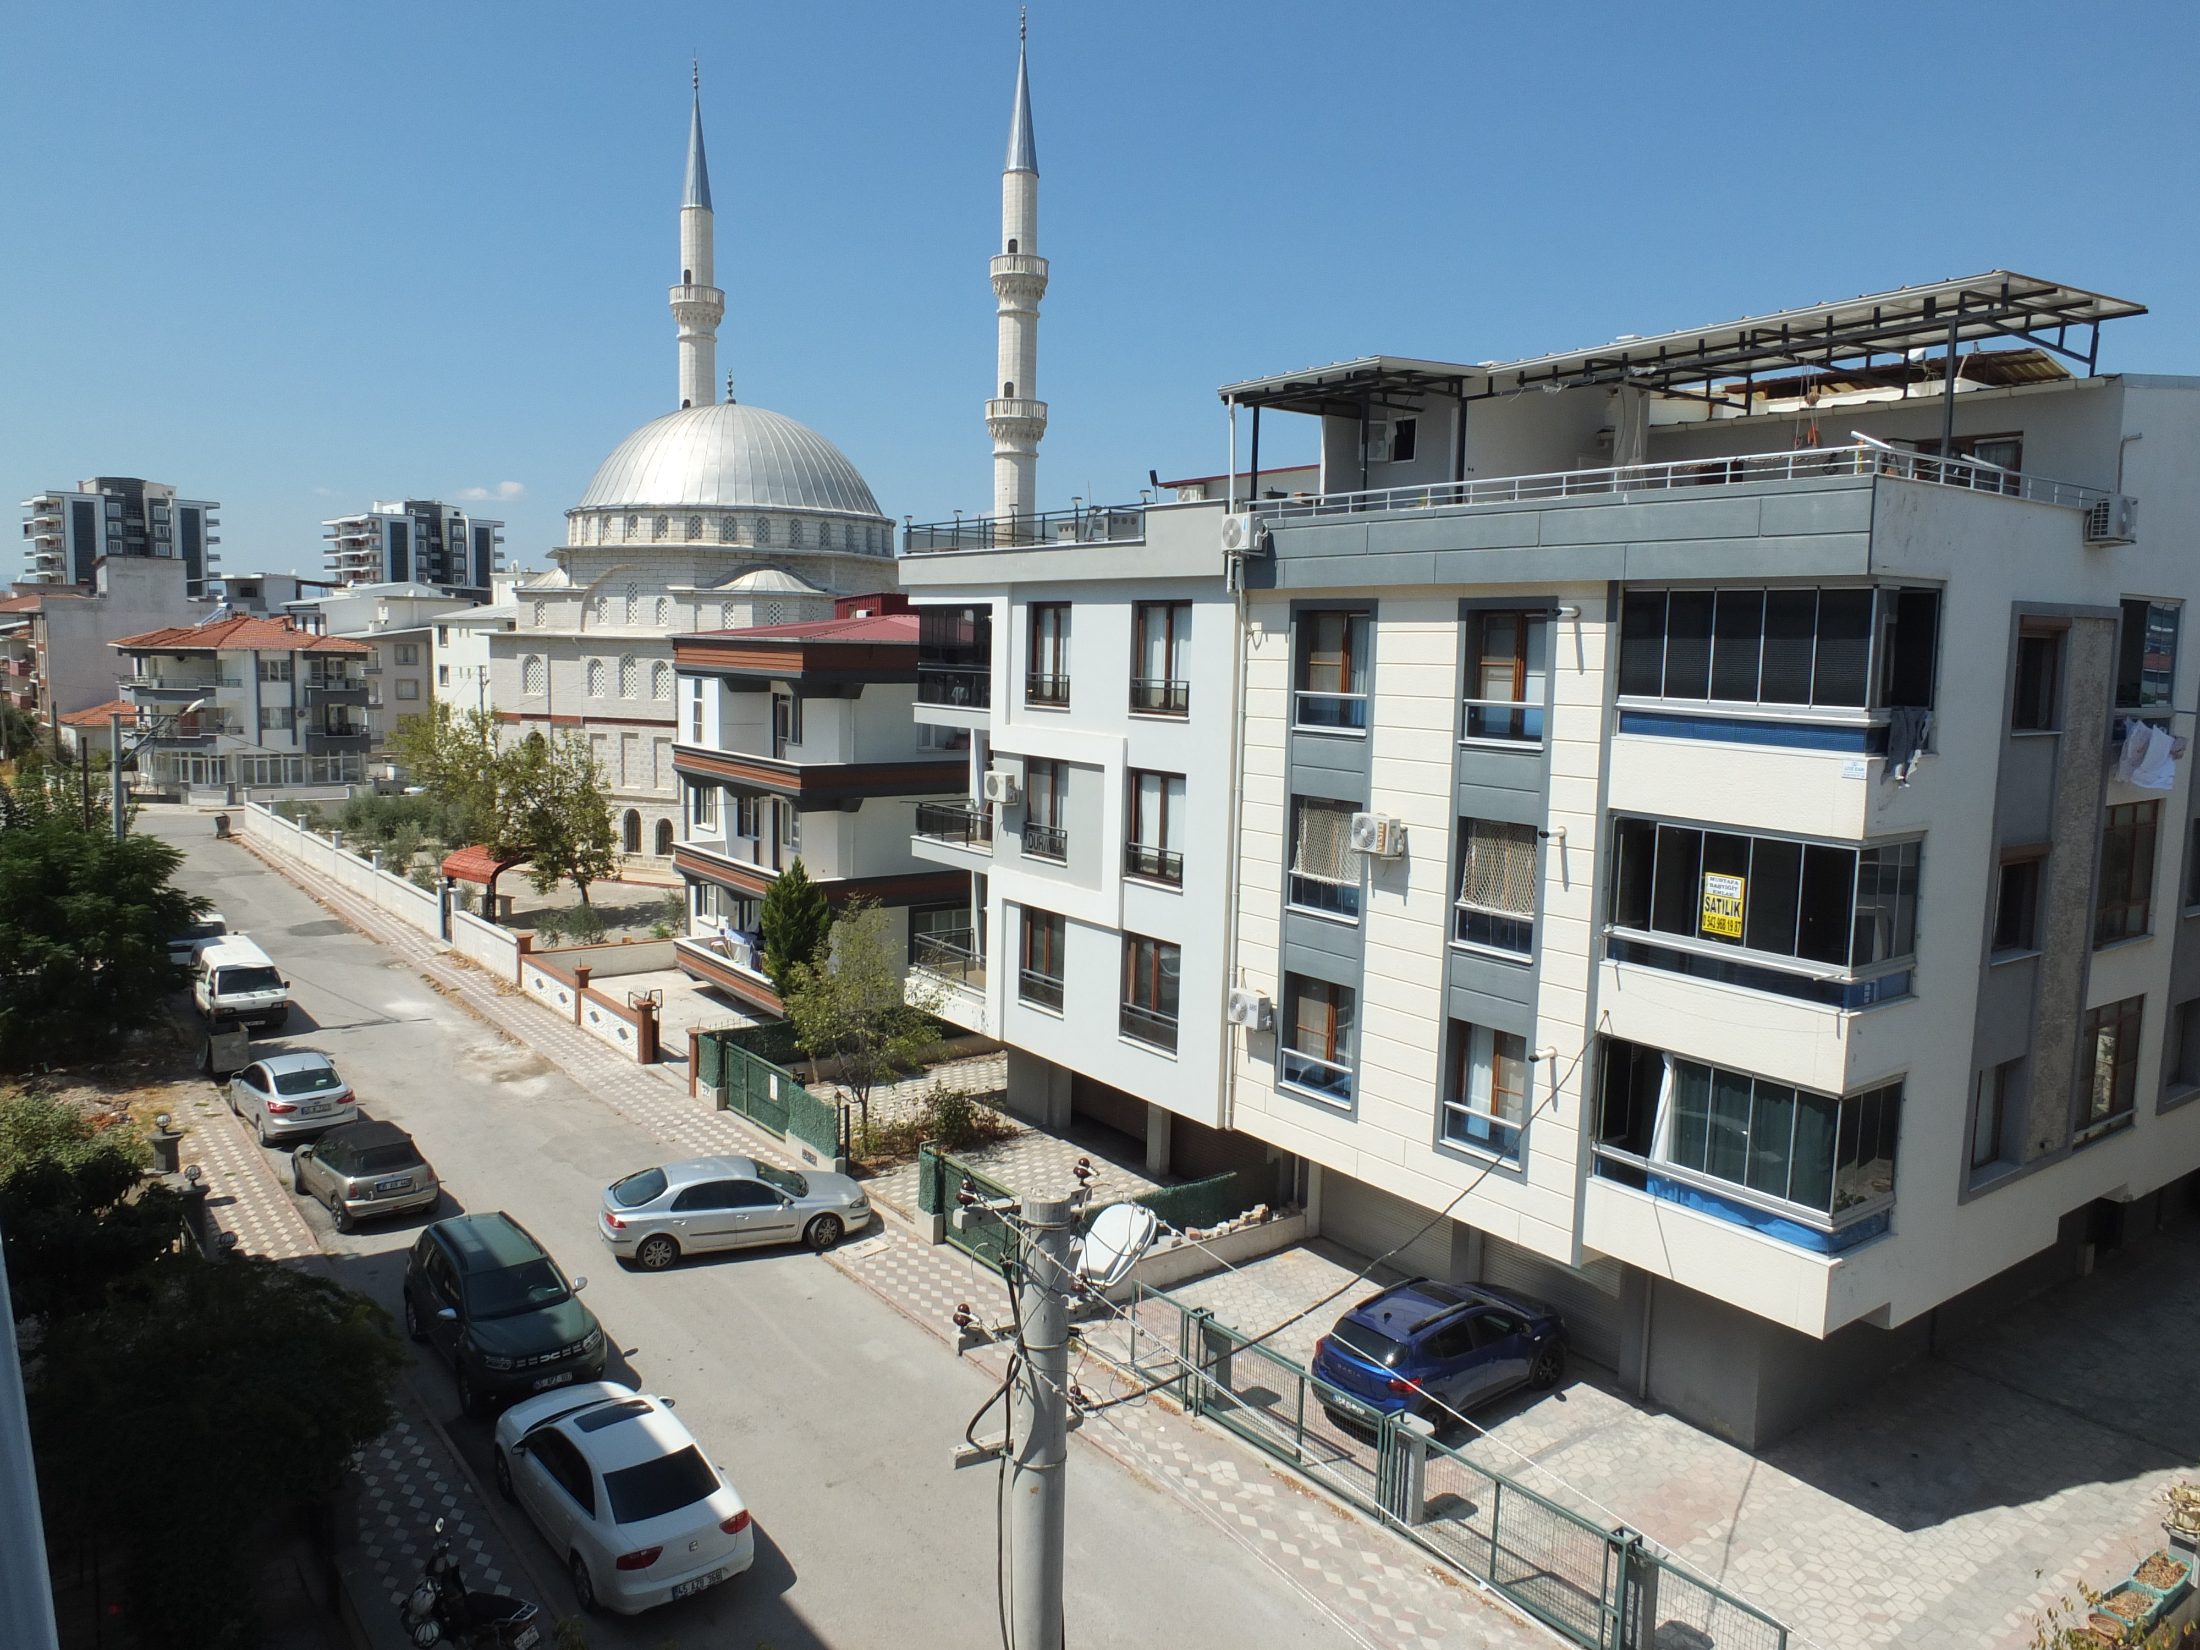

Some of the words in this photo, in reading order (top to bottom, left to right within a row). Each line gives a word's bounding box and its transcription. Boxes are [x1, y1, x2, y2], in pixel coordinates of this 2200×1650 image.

[1376, 822, 1384, 852] VESTEL
[1709, 876, 1739, 885] MUSTAFA
[1713, 889, 1734, 897] EMLAK
[1705, 896, 1741, 918] SATILIK
